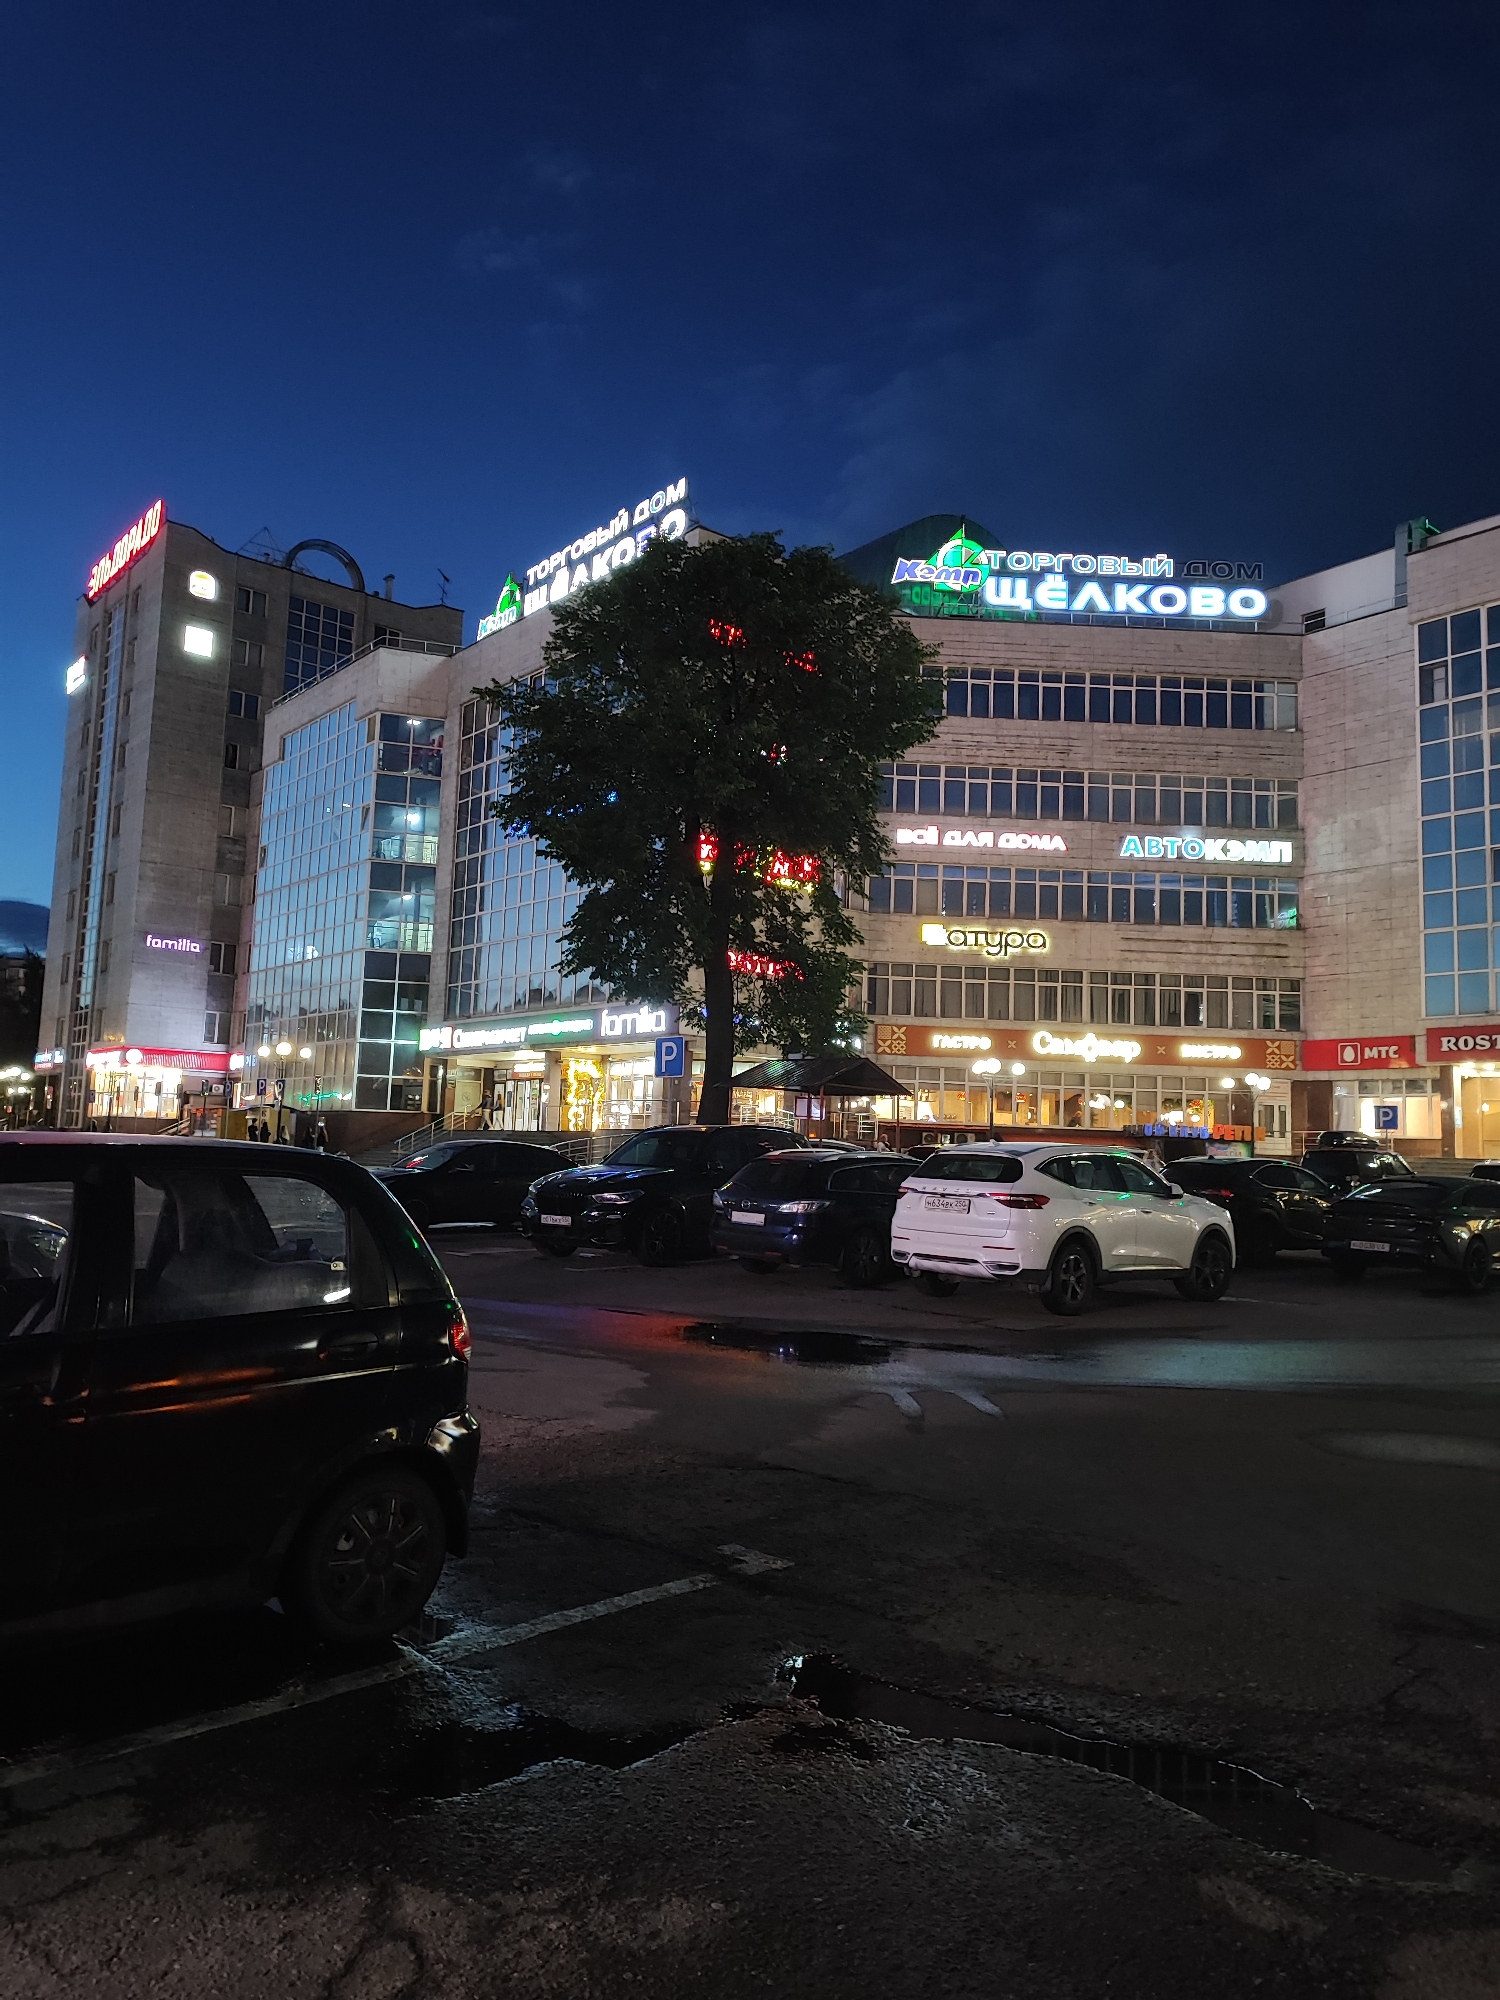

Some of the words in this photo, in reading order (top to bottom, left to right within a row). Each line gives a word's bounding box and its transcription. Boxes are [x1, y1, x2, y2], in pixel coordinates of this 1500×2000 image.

[527, 508, 629, 585] ТОРГОВЫЙ
[632, 476, 688, 526] ДОМ
[87, 499, 164, 599] ЭЛЬДОРАДО
[984, 550, 1175, 579] ТОРГОВЫЙ
[1182, 559, 1264, 582] ДОМ
[983, 571, 1269, 619] ЩЁЛКОВО
[942, 829, 995, 848] ДЛЯ
[997, 832, 1069, 852] ДОМА
[146, 934, 201, 953] familia
[932, 1033, 992, 1051] ГАСТРО
[1364, 1045, 1399, 1060] МТС
